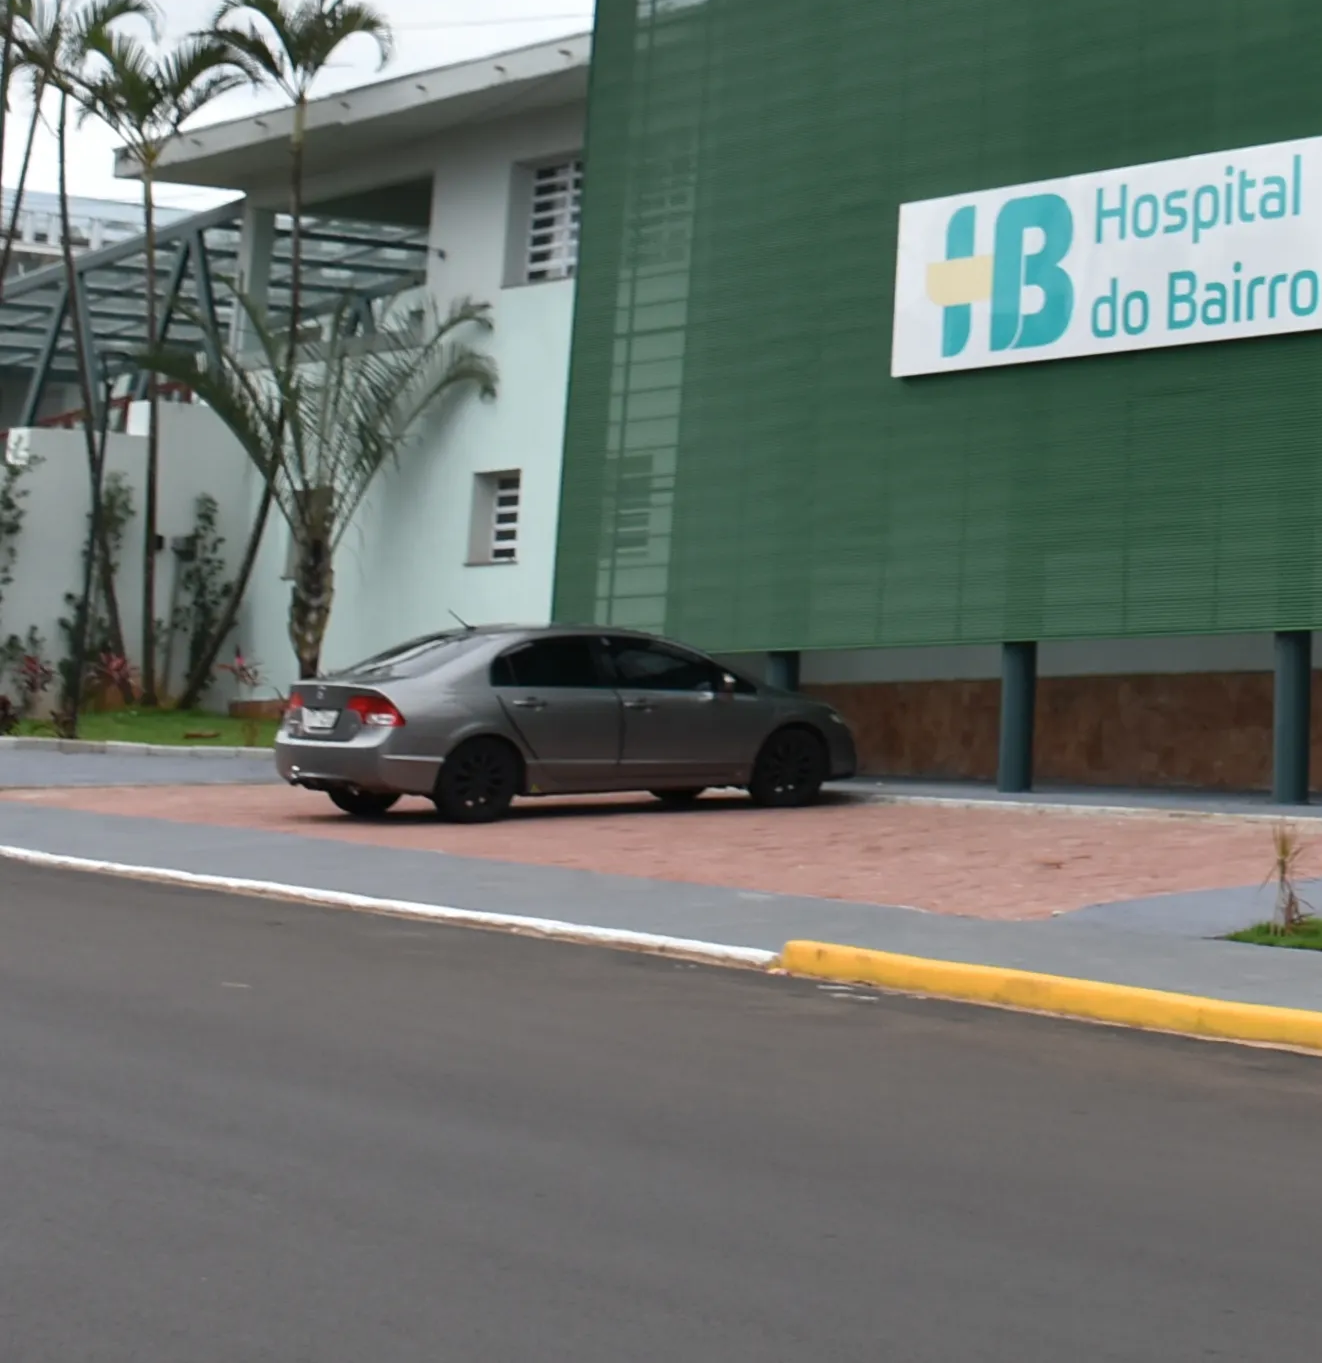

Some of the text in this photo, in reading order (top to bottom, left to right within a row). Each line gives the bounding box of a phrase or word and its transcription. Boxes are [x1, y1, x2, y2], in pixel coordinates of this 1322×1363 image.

[1095, 154, 1302, 243] Hospital
[1091, 261, 1320, 338] do Bairro
